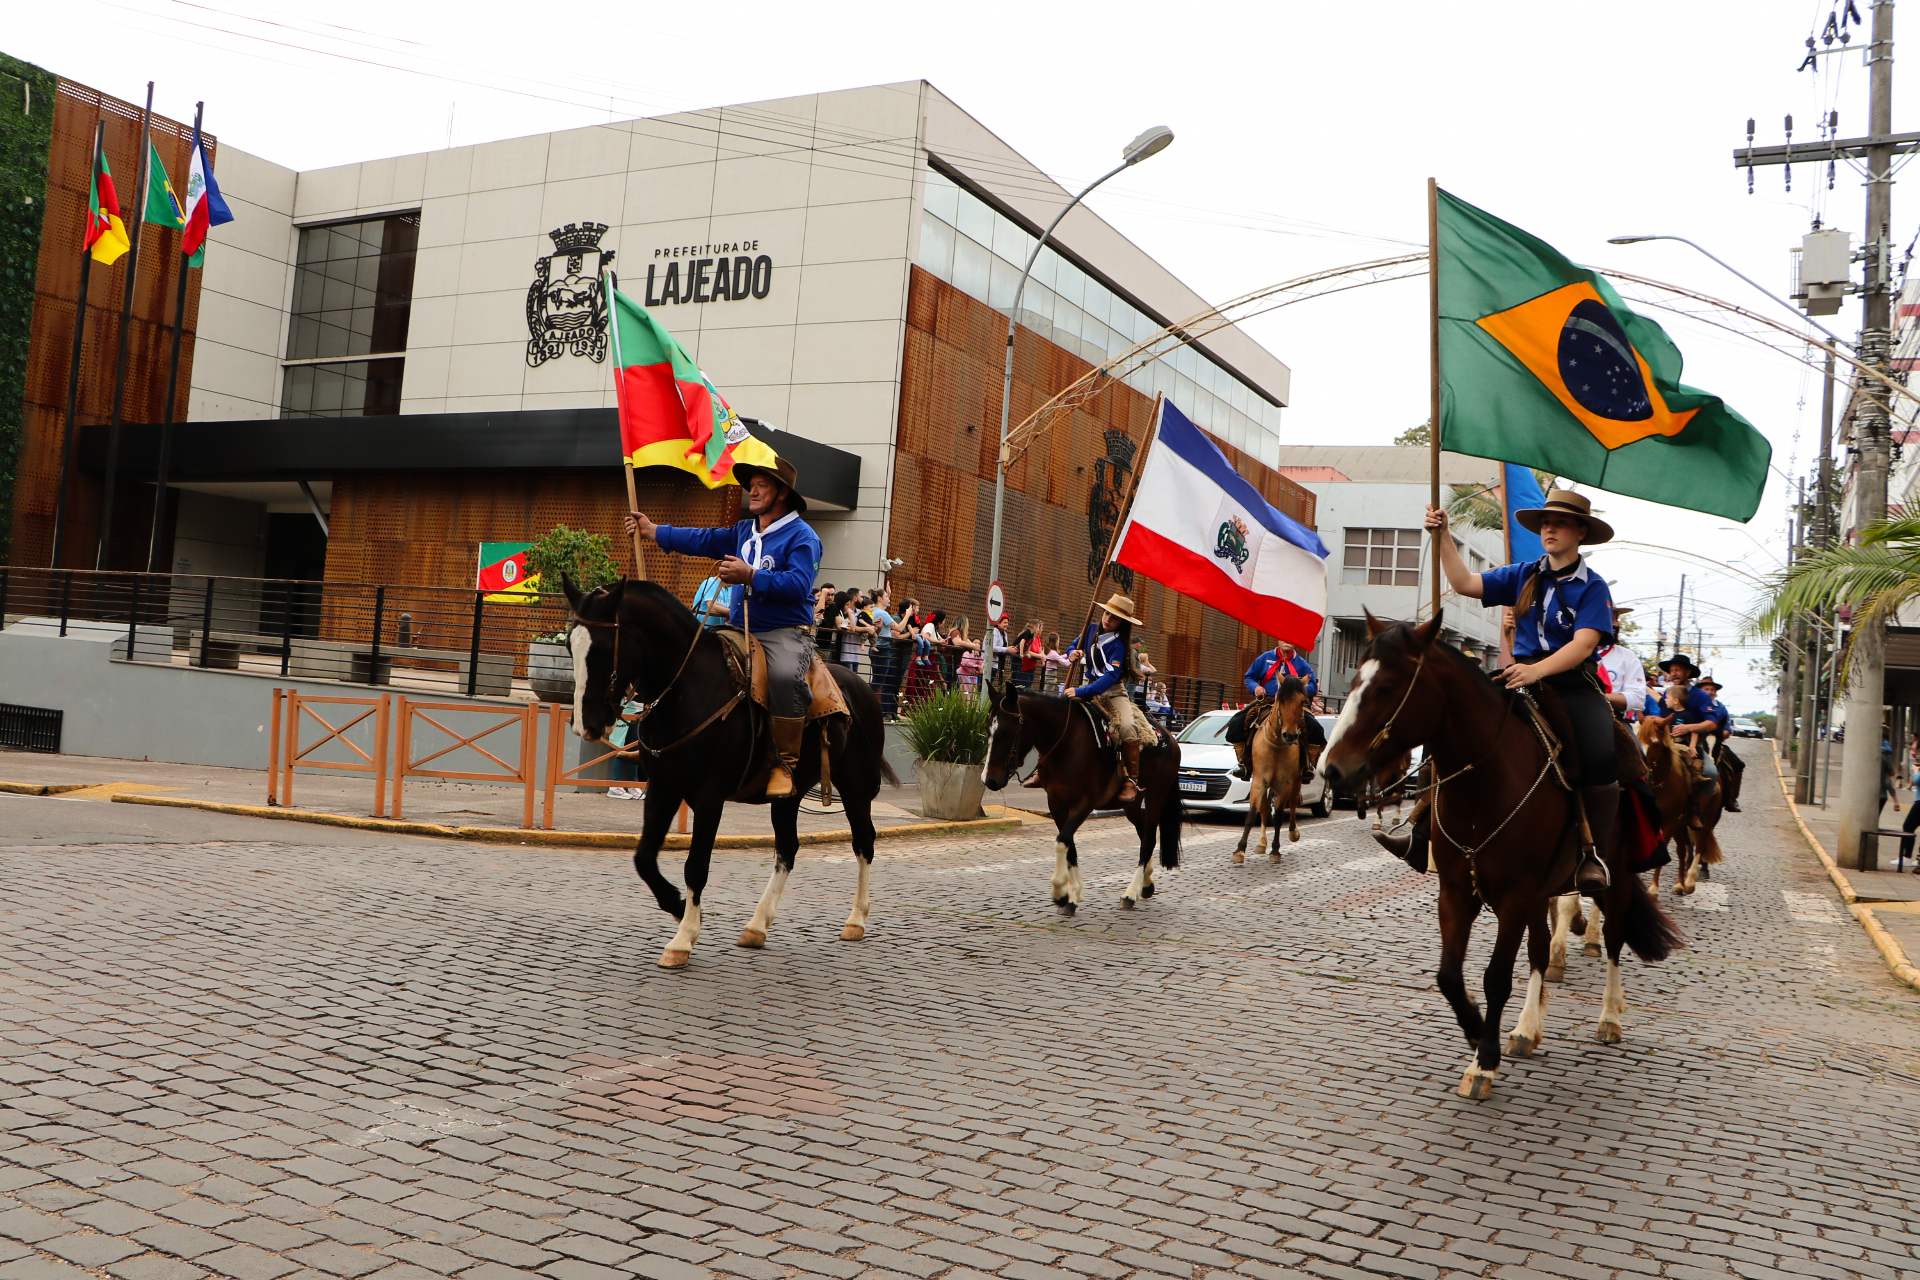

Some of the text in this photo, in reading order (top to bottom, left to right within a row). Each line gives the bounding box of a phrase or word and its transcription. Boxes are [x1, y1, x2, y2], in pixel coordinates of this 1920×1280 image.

[654, 240, 759, 258] PREFEITURA DE
[645, 255, 772, 307] LAJEADO
[533, 342, 560, 364] 1891
[575, 340, 603, 361] 1939
